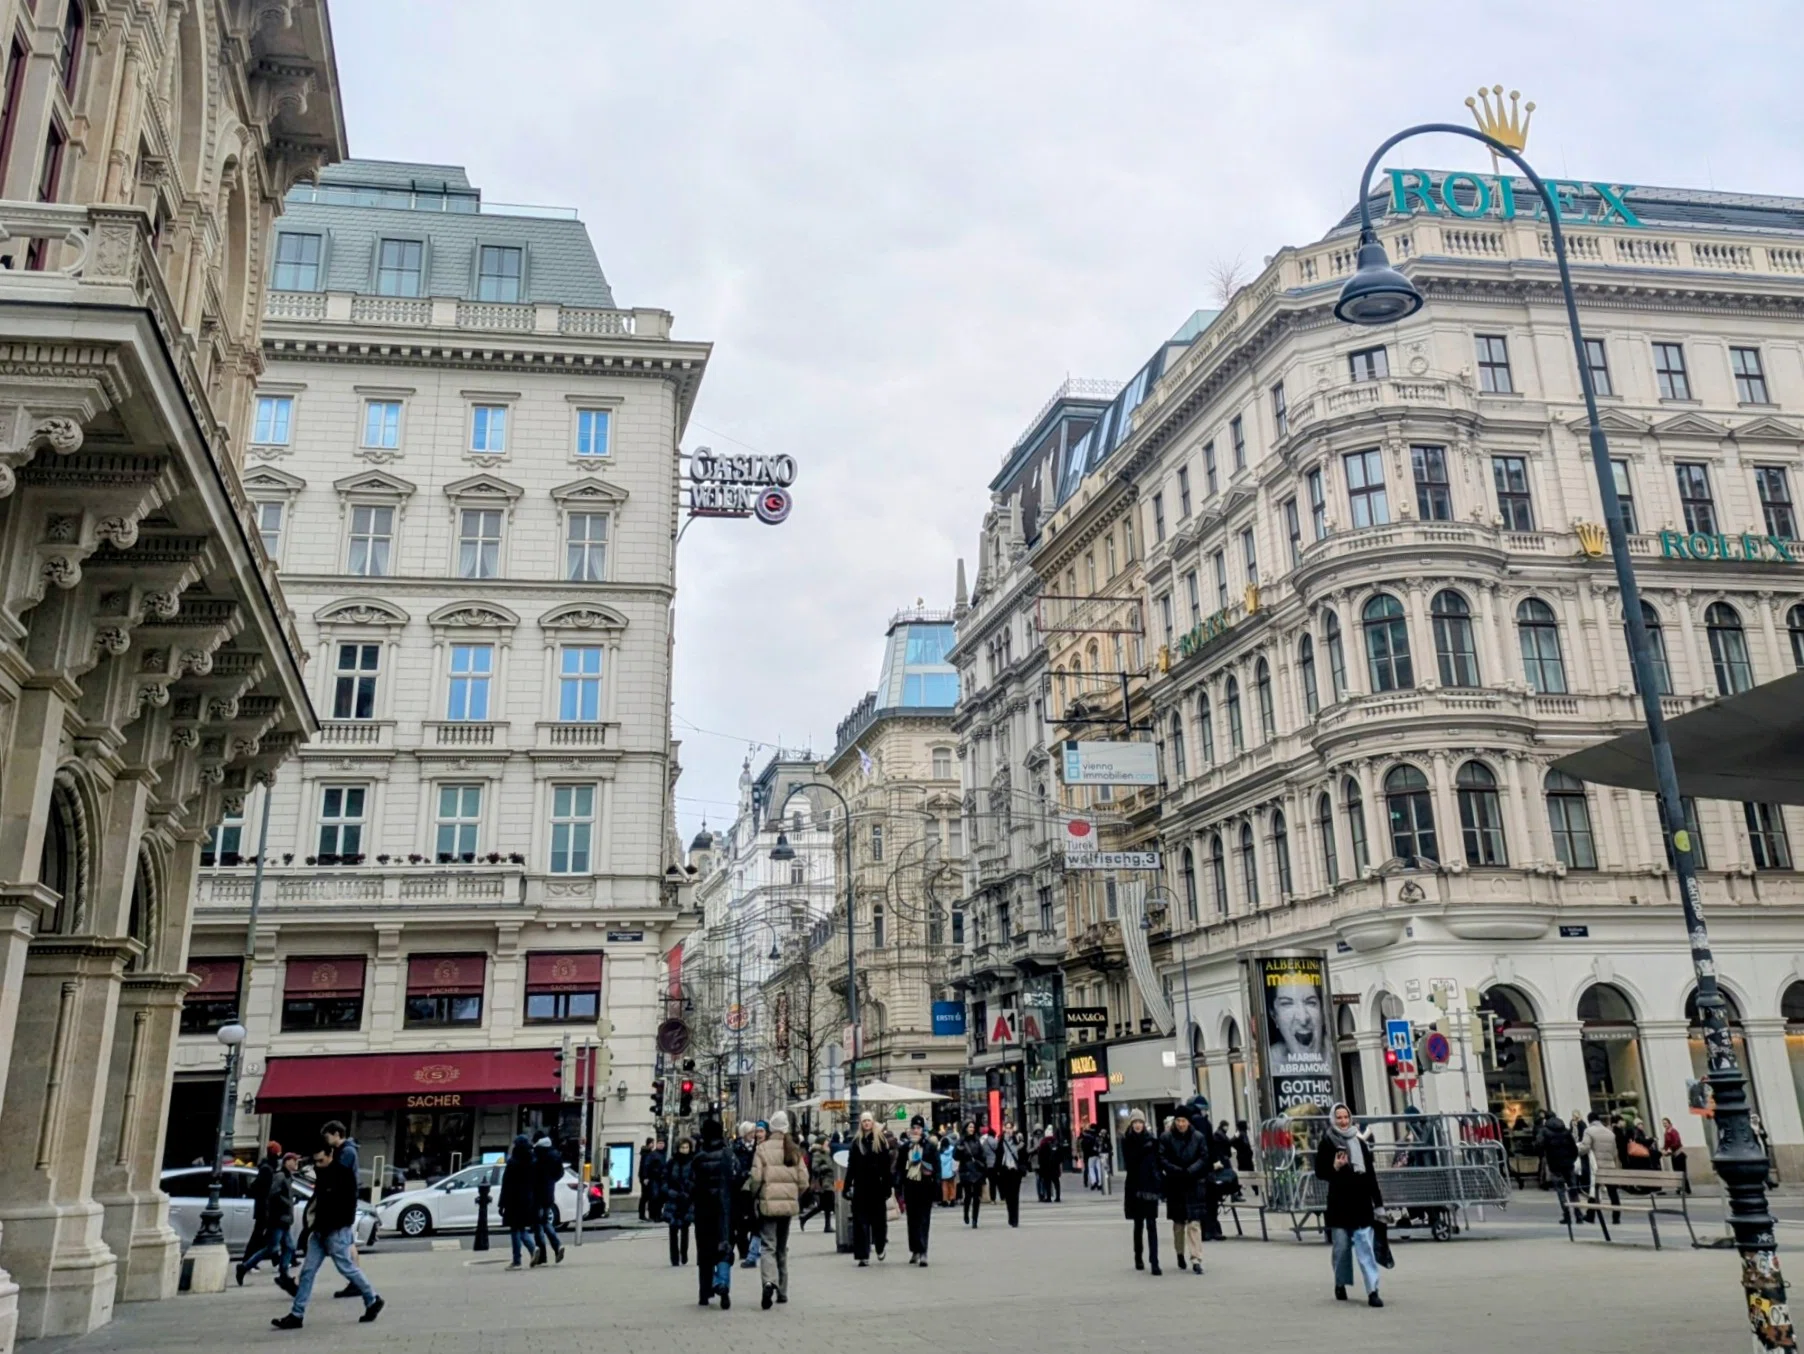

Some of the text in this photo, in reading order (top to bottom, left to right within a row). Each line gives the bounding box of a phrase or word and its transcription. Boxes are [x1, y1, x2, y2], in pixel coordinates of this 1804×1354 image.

[1383, 168, 1649, 229] ROLEX
[690, 446, 798, 488] CASINO
[690, 485, 753, 512] WIEN
[1659, 530, 1798, 562] ROLEX
[1266, 970, 1321, 986] modern
[936, 1014, 954, 1022] ERSTE
[992, 1012, 1016, 1042] A1
[1287, 1052, 1323, 1062] MARINA
[1281, 1079, 1331, 1094] GOTHIC
[407, 1095, 461, 1107] SACHER
[1279, 1094, 1334, 1108] MODERN
